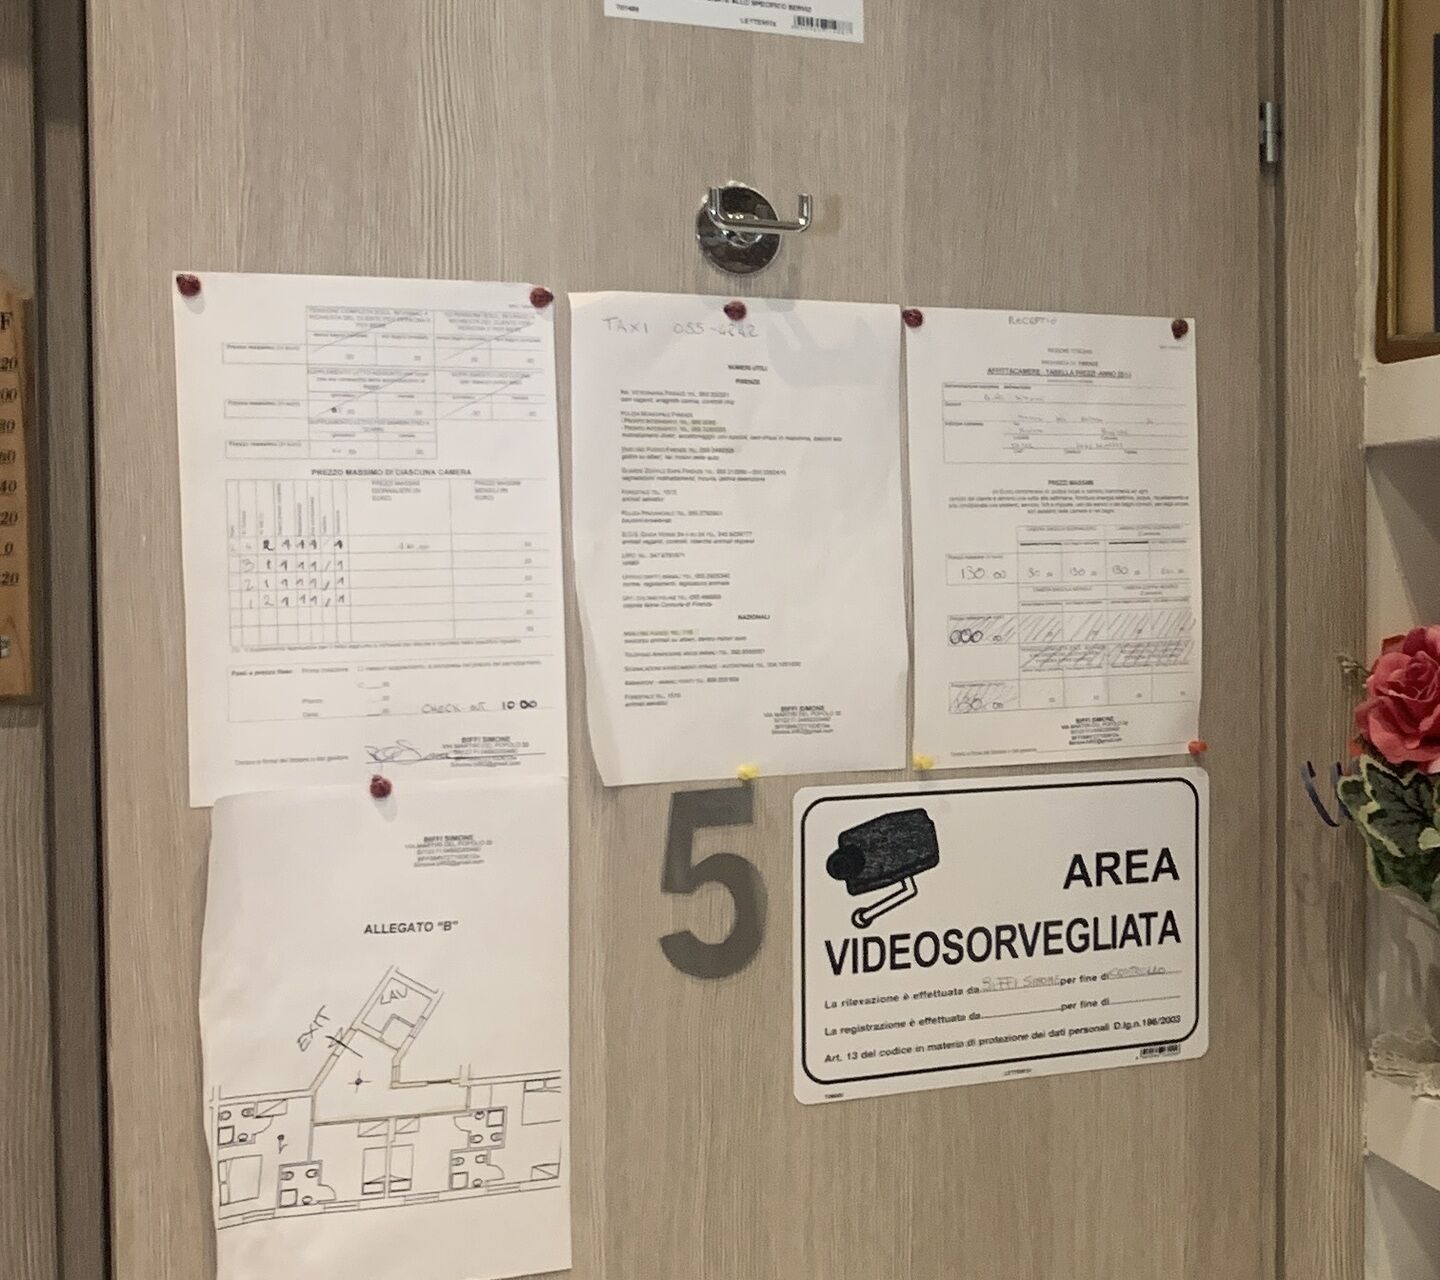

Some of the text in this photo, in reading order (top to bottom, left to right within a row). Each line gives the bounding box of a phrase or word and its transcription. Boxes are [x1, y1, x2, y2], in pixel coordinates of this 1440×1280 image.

[659, 785, 768, 980] 5
[1063, 847, 1180, 889] AREA
[363, 922, 433, 934] ALLEGATO
[825, 910, 1181, 976] VIDEOSORVEGLIATA
[824, 1000, 837, 1009] La
[841, 993, 900, 1008] rilevazione
[913, 987, 964, 1001] effettuata
[1060, 975, 1075, 986] per
[1079, 973, 1098, 983] fine
[1101, 972, 1110, 981] di
[297, 1005, 331, 1052] EXIT
[824, 1027, 837, 1036] La
[840, 1021, 906, 1036] registrazione
[919, 1013, 967, 1027] effettuata
[1060, 1000, 1076, 1012] per
[1080, 999, 1098, 1009] fine
[1101, 997, 1110, 1006] di
[824, 1053, 843, 1063] Art.
[847, 1051, 858, 1061] 13
[879, 1045, 913, 1057] codice
[915, 1045, 925, 1054] in
[927, 1040, 964, 1051] materia
[979, 1033, 1030, 1047] protezione
[1048, 1028, 1066, 1038] dati
[1069, 1022, 1110, 1036] personali
